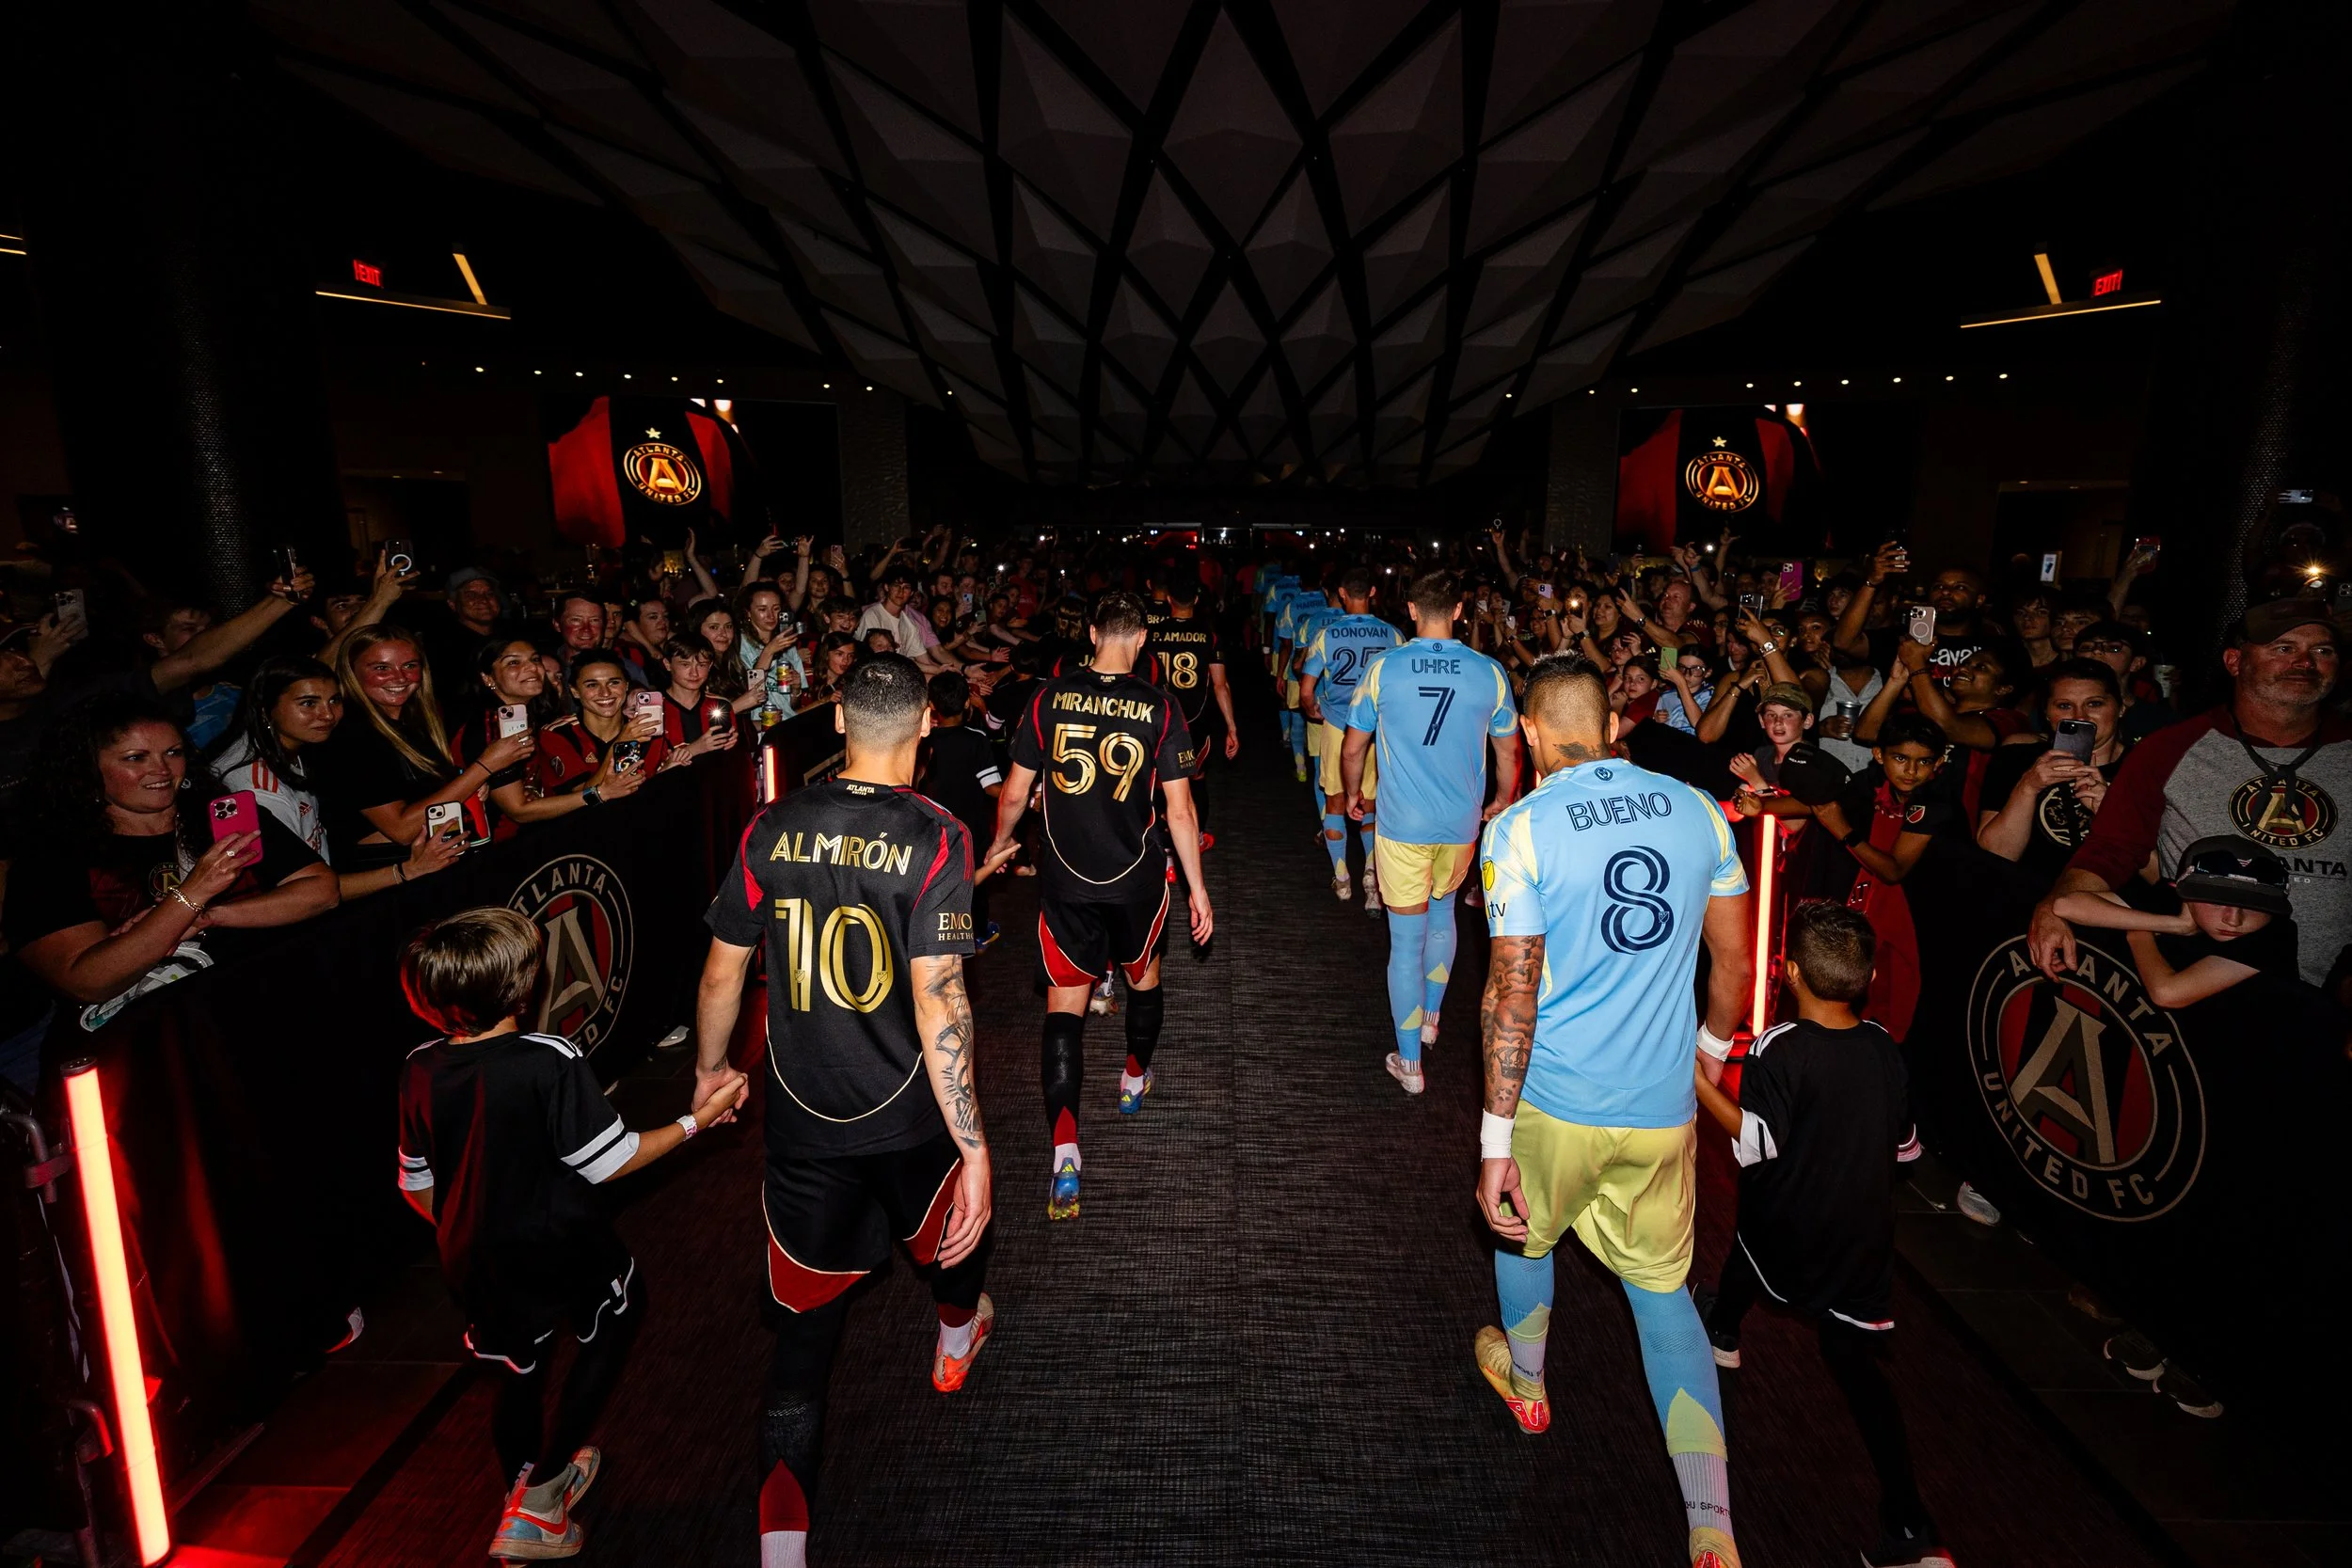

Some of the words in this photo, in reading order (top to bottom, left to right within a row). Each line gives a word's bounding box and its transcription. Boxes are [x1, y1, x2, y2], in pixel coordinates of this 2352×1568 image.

[358, 263, 381, 287] EXIT
[2094, 272, 2119, 296] EXIT
[633, 445, 684, 462] ATLANTA
[1696, 453, 1746, 468] ATLANTA
[638, 483, 682, 503] UNITED
[683, 487, 695, 499] FC
[1695, 490, 1737, 511] UNITED
[1738, 495, 1751, 506] FC
[1331, 626, 1388, 639] DONOVAN
[1157, 651, 1199, 689] 18
[1411, 658, 1461, 674] UHRE
[1052, 691, 1154, 723] MIRANCHUK
[1418, 686, 1455, 746] 7
[1051, 722, 1145, 802] 59
[2247, 779, 2318, 798] ATATA
[1565, 792, 1672, 832] BUENO
[2242, 822, 2299, 846] NITED
[2306, 828, 2324, 843] FC
[770, 832, 913, 875] ALMIRÓN
[514, 862, 606, 916] TLANTA
[1600, 846, 1674, 956] 8
[937, 912, 973, 931] EMO
[1489, 900, 1506, 918] tv
[774, 897, 894, 1014] 10
[604, 975, 623, 1015] FC
[2009, 949, 2173, 1057] AANTA
[1983, 1070, 2089, 1200] UNITED
[2106, 1173, 2154, 1210] FC
